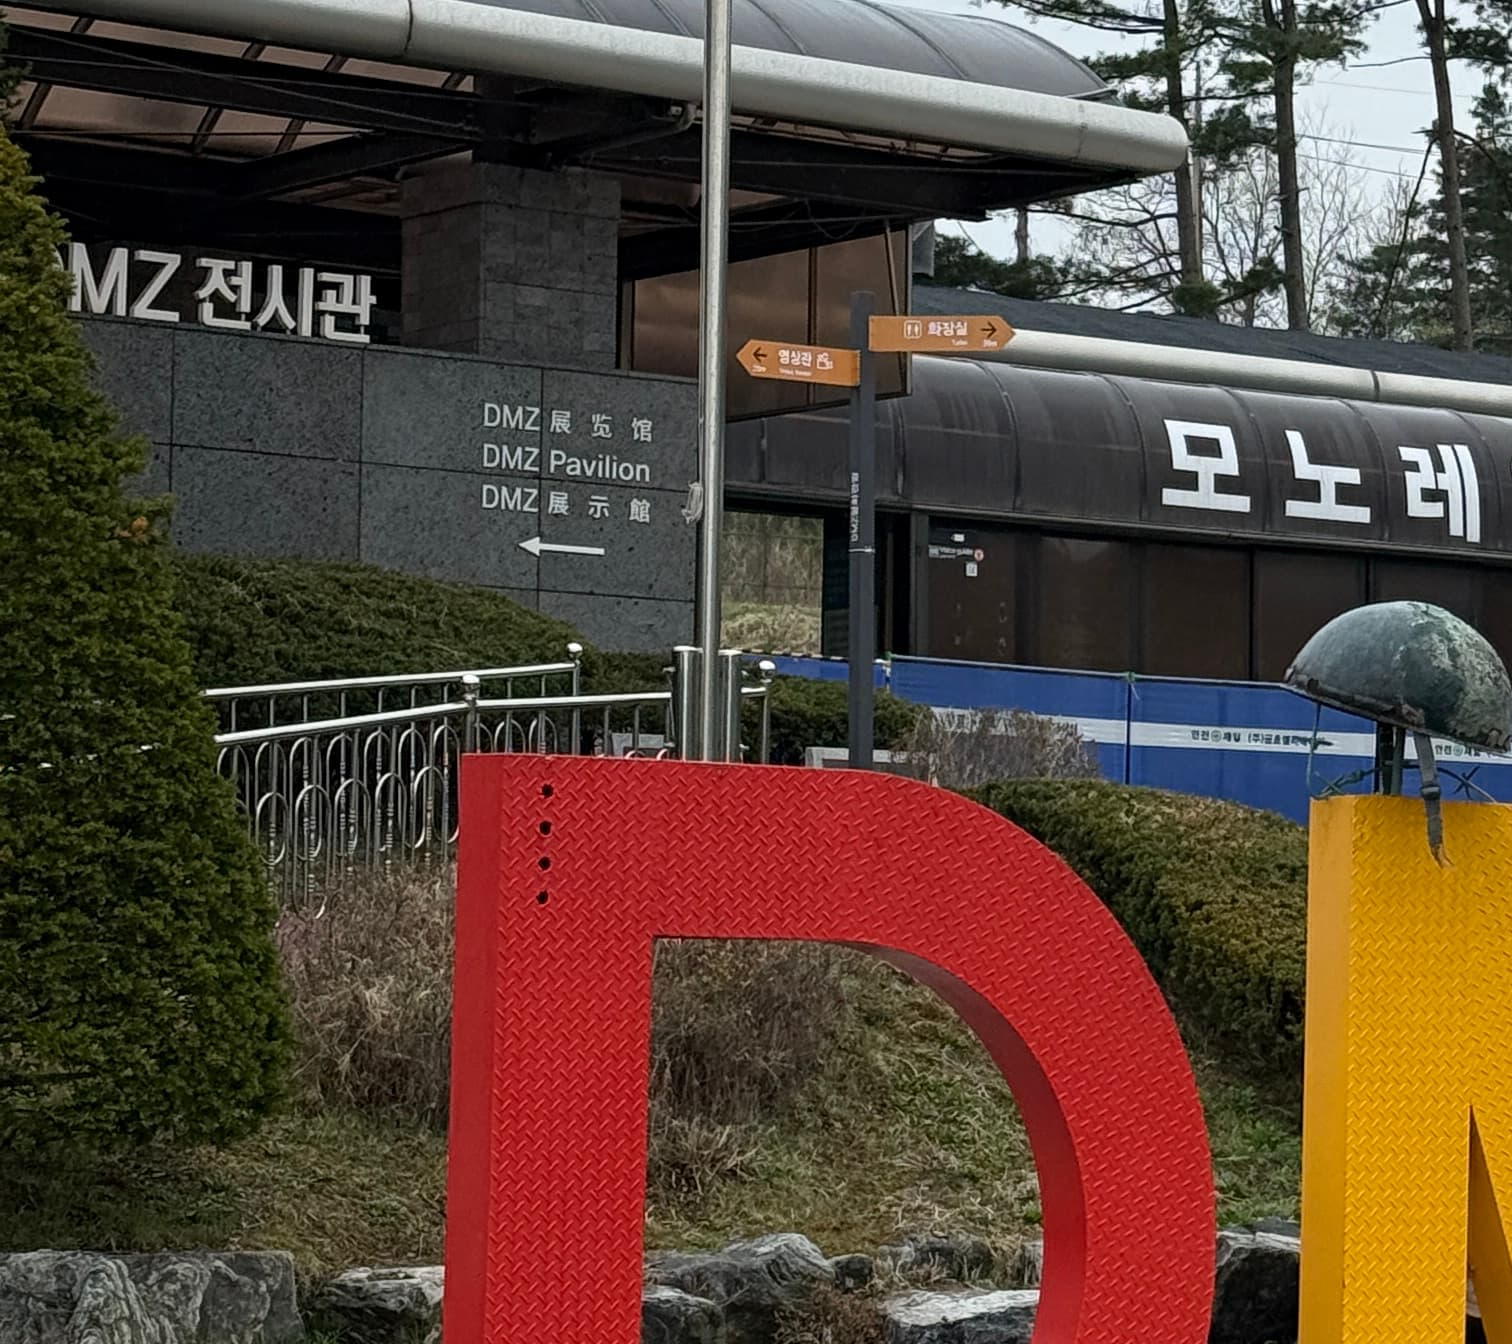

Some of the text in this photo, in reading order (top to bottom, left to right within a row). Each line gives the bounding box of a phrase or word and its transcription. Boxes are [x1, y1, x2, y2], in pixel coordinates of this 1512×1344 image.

[53, 242, 377, 343] MZ 전시관
[928, 321, 968, 337] 화장실
[778, 349, 812, 367] 영상관
[483, 403, 541, 431] DMZ
[482, 443, 650, 482] DMZ Pavilion
[481, 484, 539, 513] DMZ
